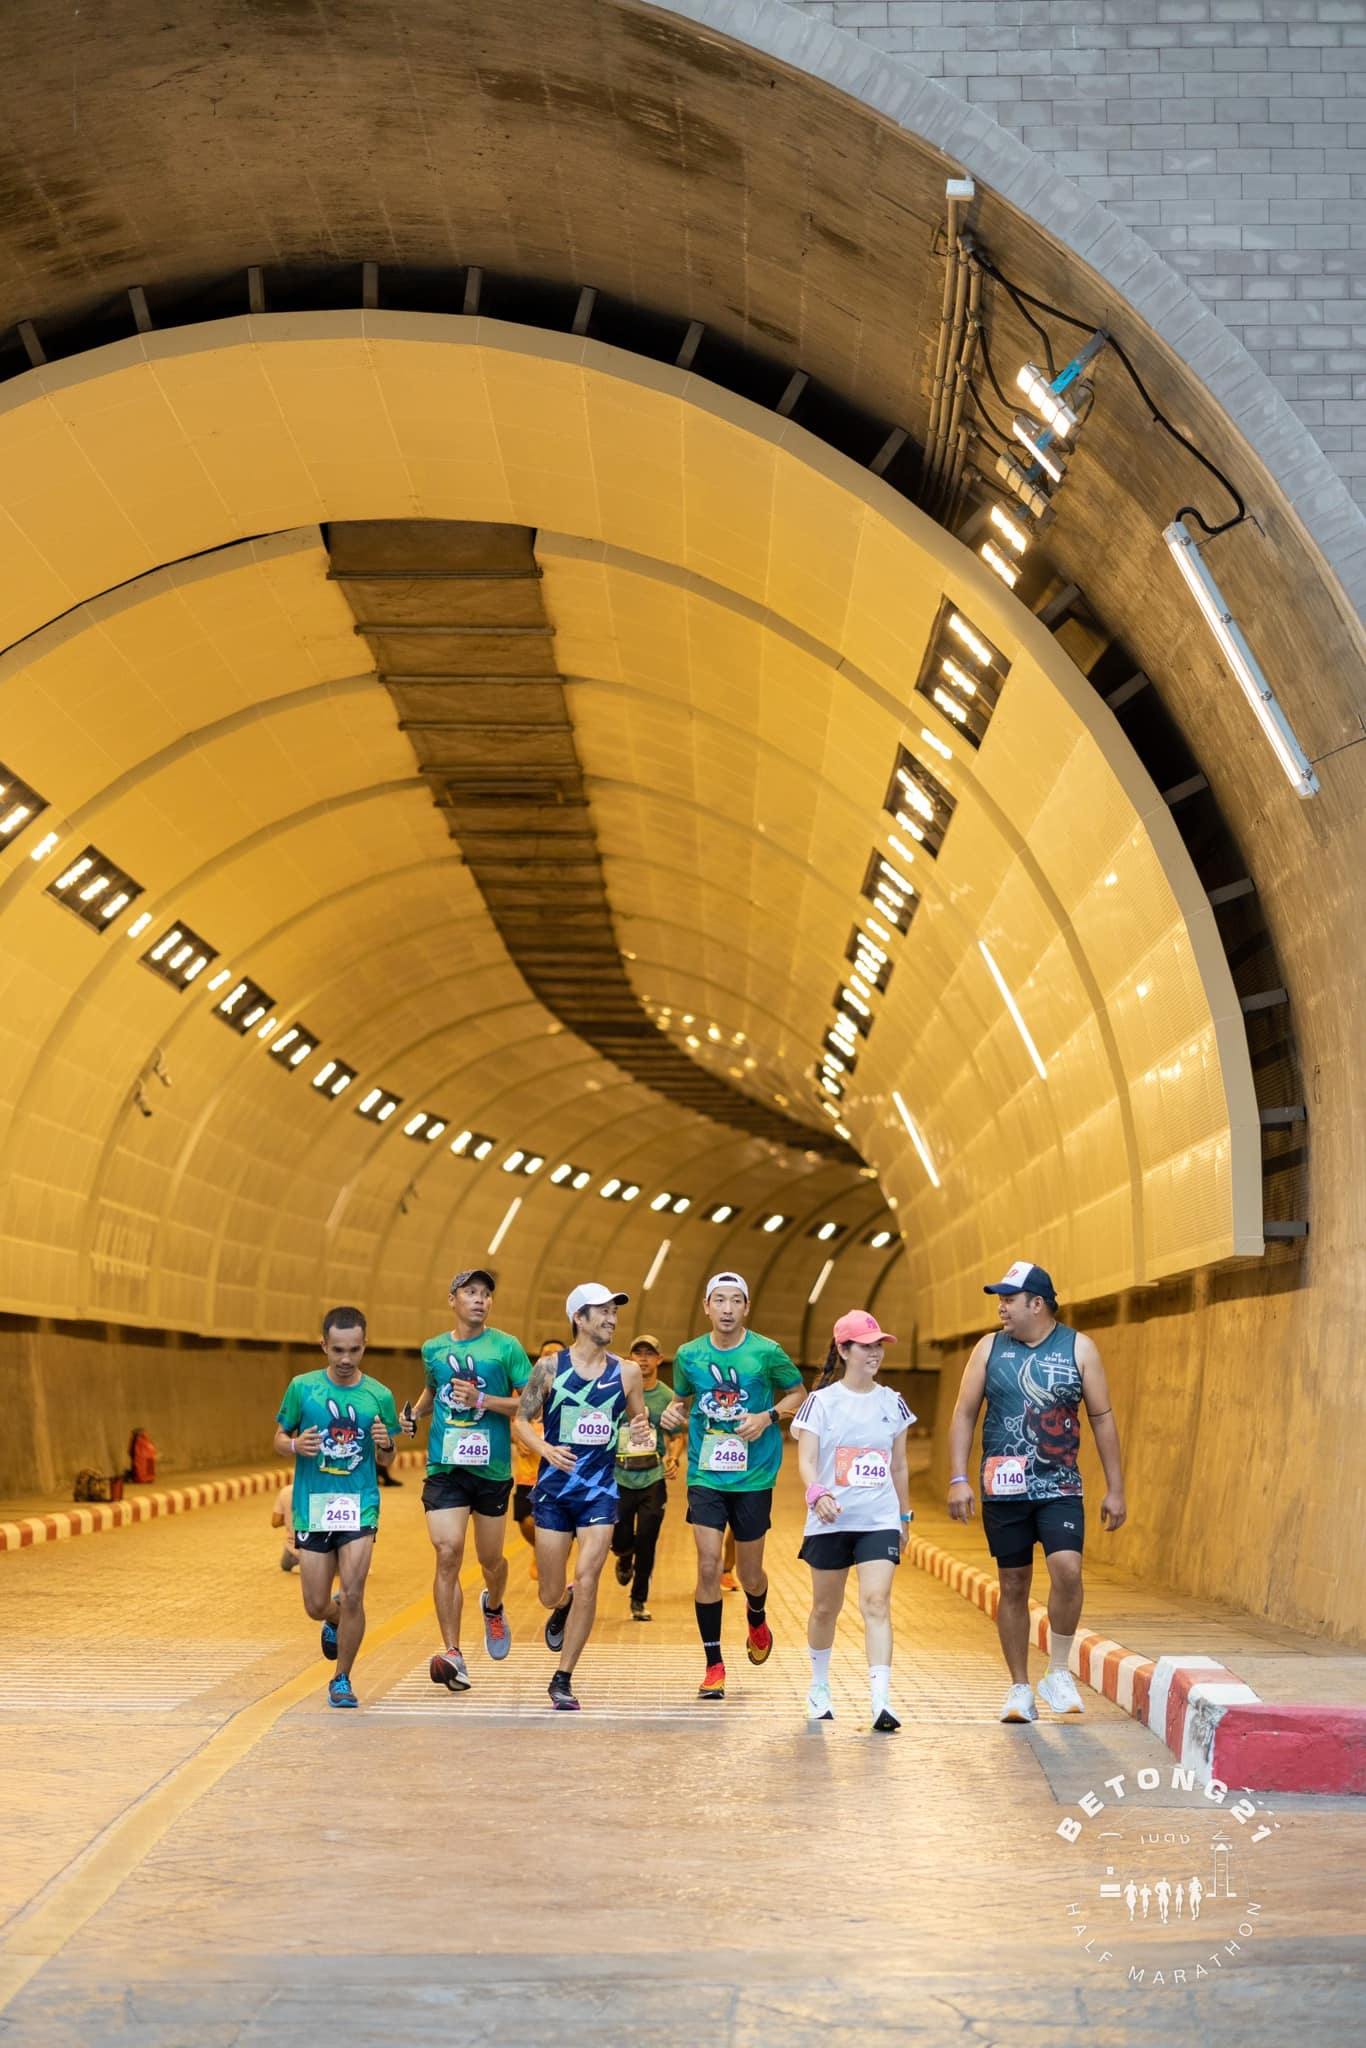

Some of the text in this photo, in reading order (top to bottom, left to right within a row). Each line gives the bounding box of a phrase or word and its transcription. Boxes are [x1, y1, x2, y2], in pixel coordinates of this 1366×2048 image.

[578, 1423, 610, 1435] 0030
[458, 1444, 489, 1456] 2485
[715, 1450, 746, 1462] 2486
[855, 1464, 887, 1478] 1248
[996, 1472, 1024, 1485] 1140
[326, 1510, 357, 1521] 2451
